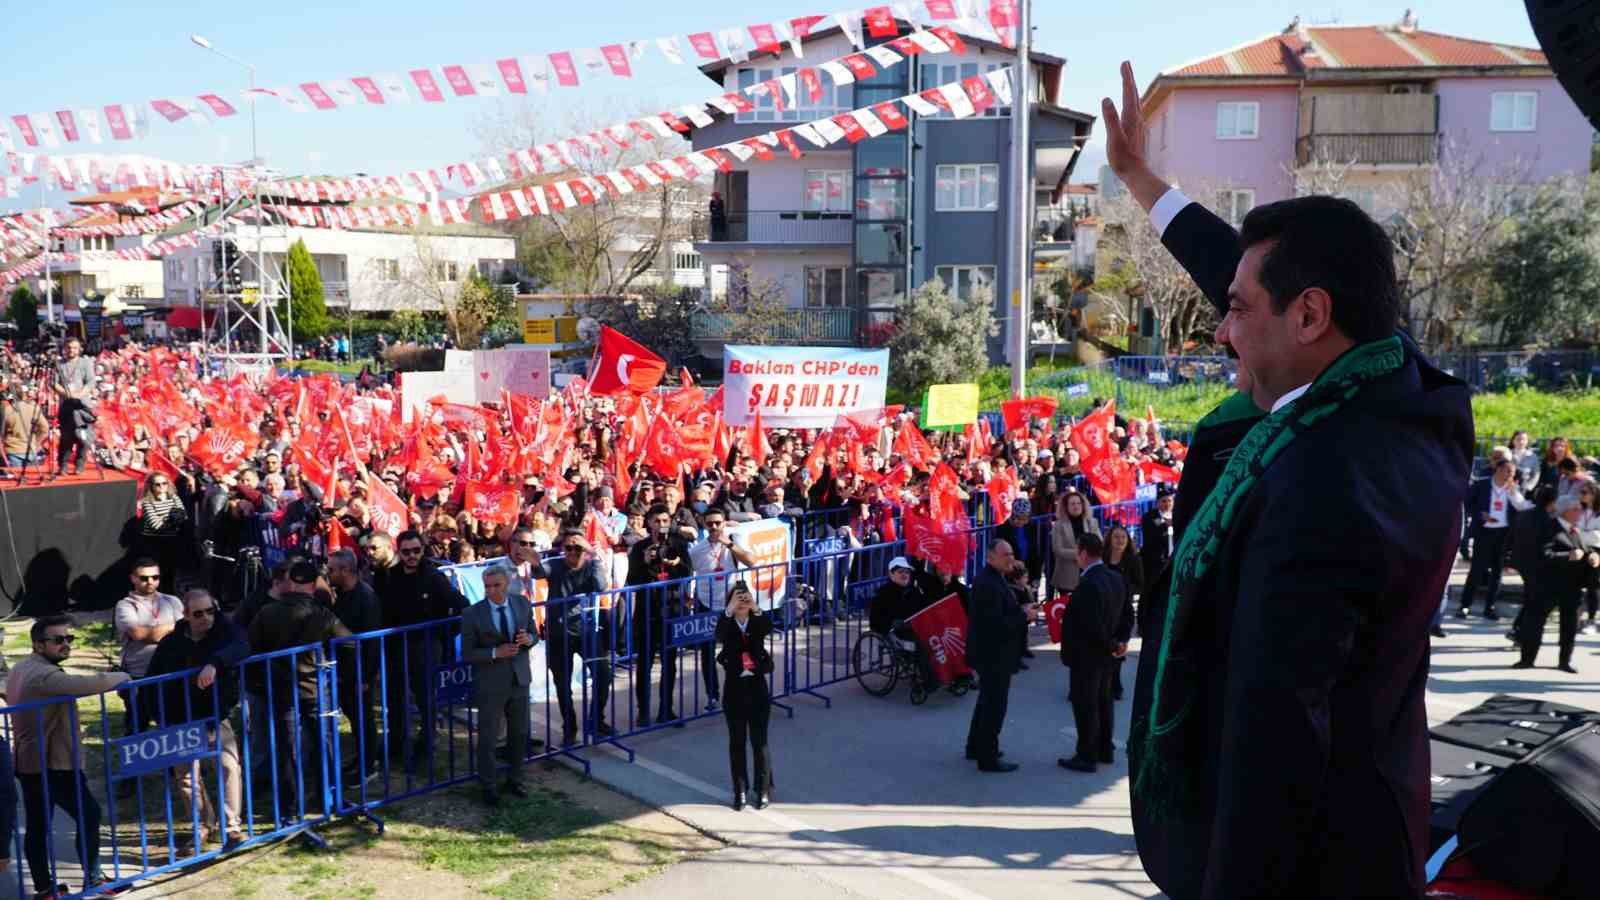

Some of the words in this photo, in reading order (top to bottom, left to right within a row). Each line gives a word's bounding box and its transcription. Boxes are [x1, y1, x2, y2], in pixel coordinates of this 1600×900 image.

[728, 359, 794, 375] Baklan
[802, 360, 880, 377] CHP'den
[748, 383, 860, 414] ŞAŞMAZ!
[123, 727, 201, 766] POLIS
